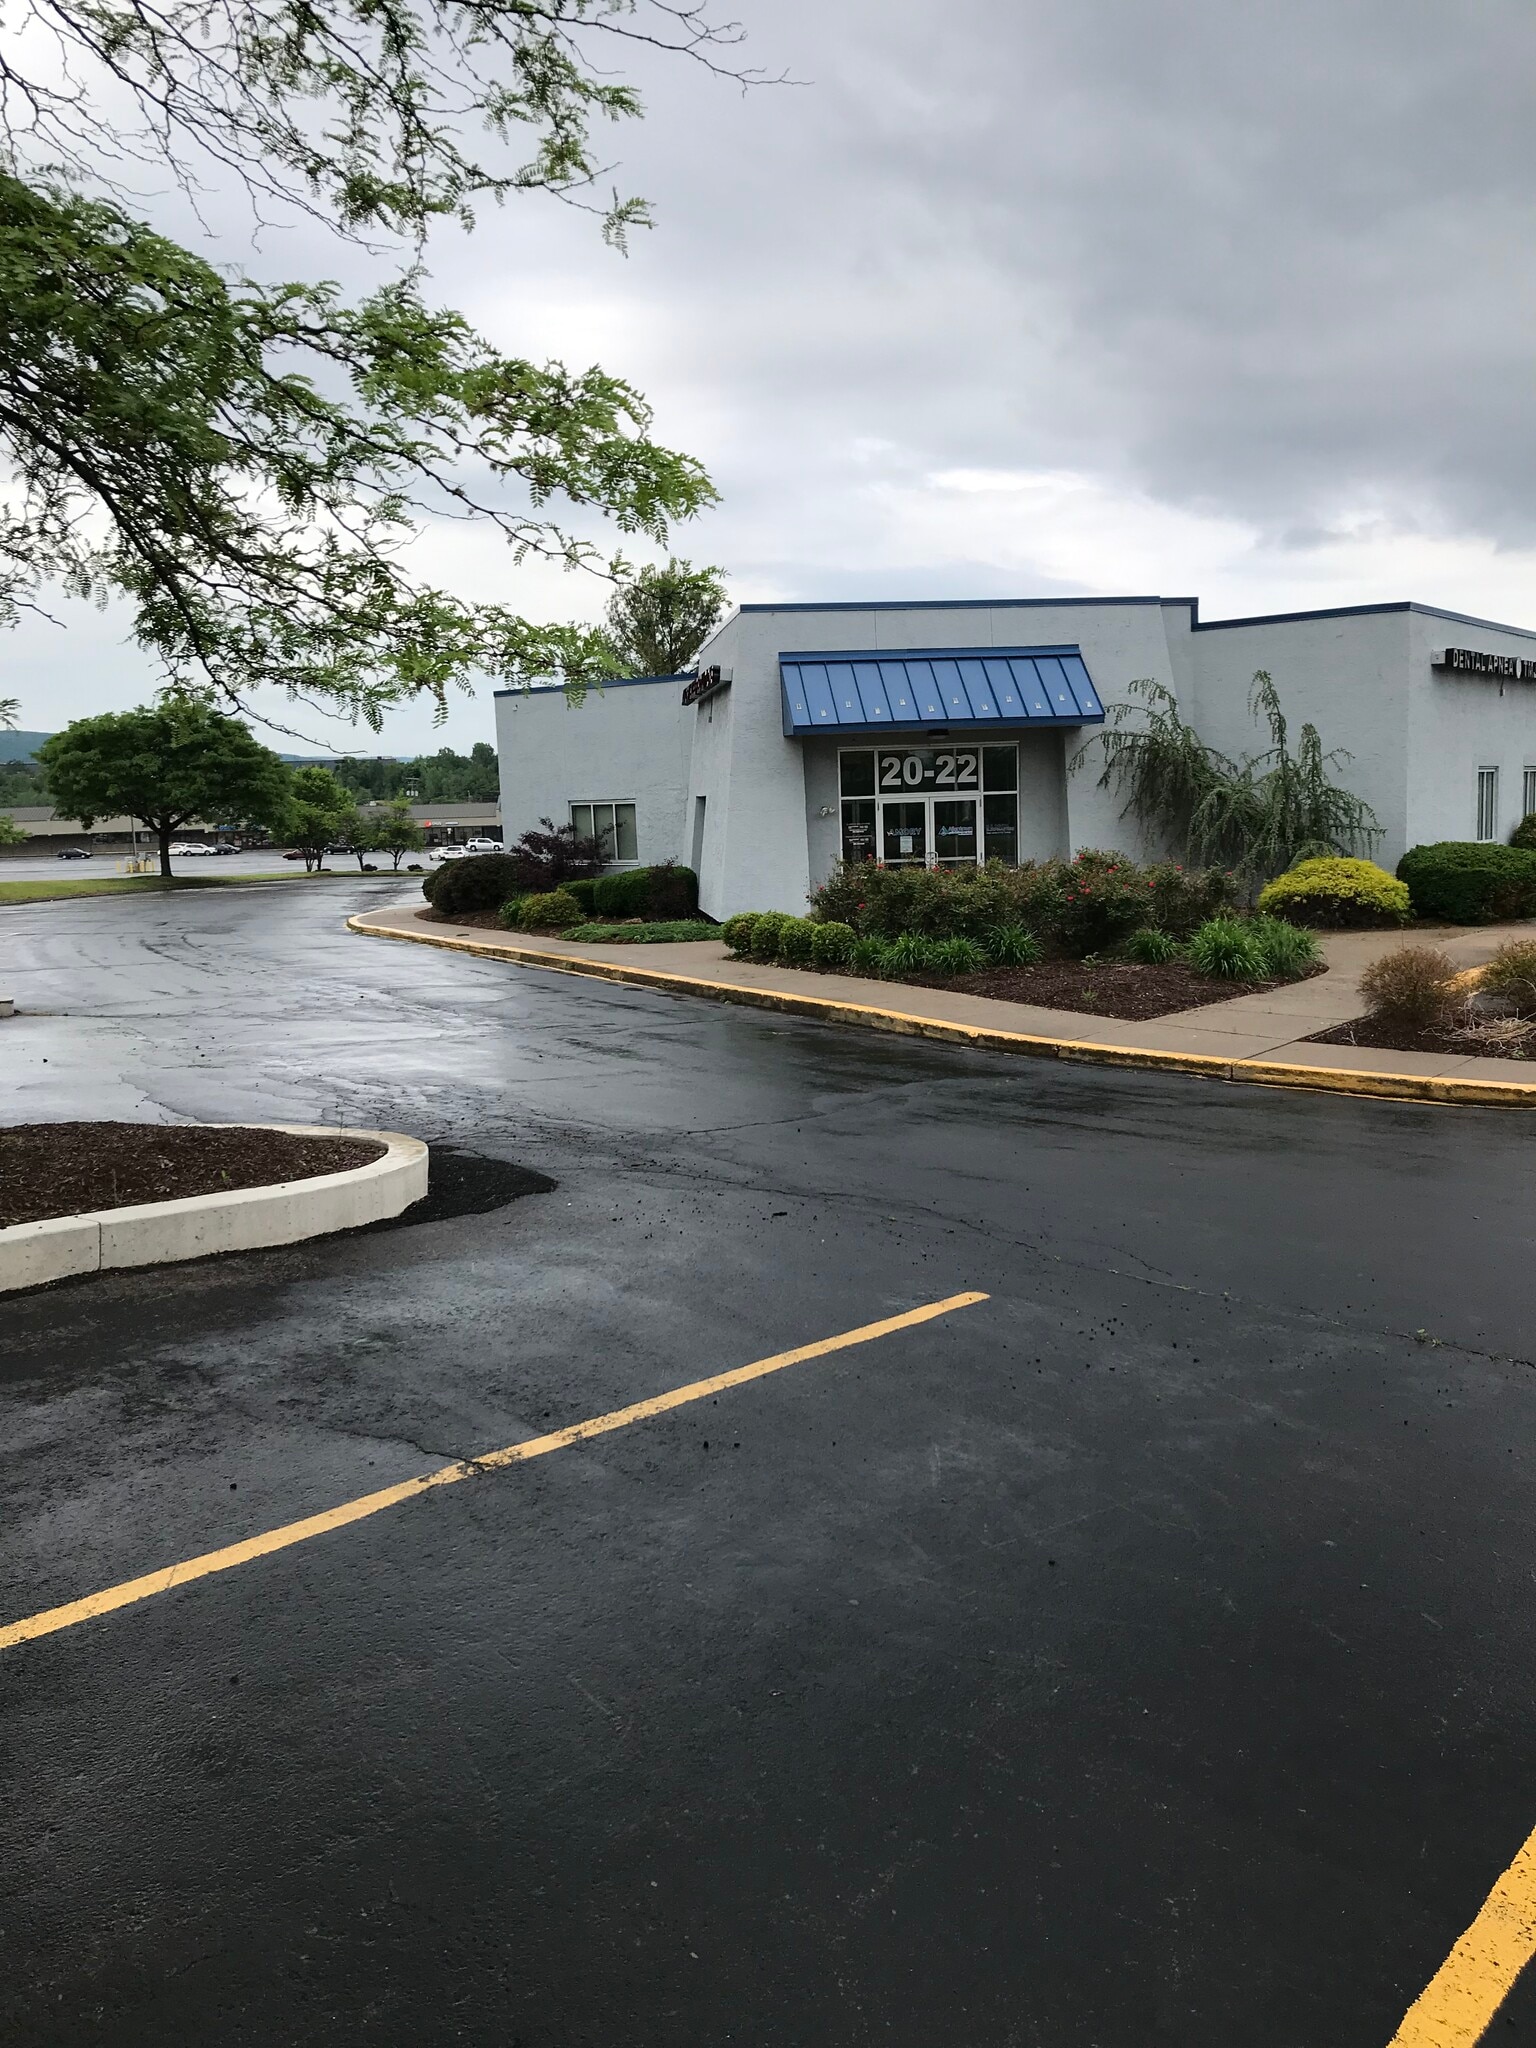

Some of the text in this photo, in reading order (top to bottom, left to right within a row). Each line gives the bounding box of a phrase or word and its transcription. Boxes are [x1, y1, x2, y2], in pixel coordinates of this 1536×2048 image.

[1453, 649, 1485, 671] DENTAL
[1488, 657, 1514, 676] APNEA
[881, 754, 978, 786] 20-22
